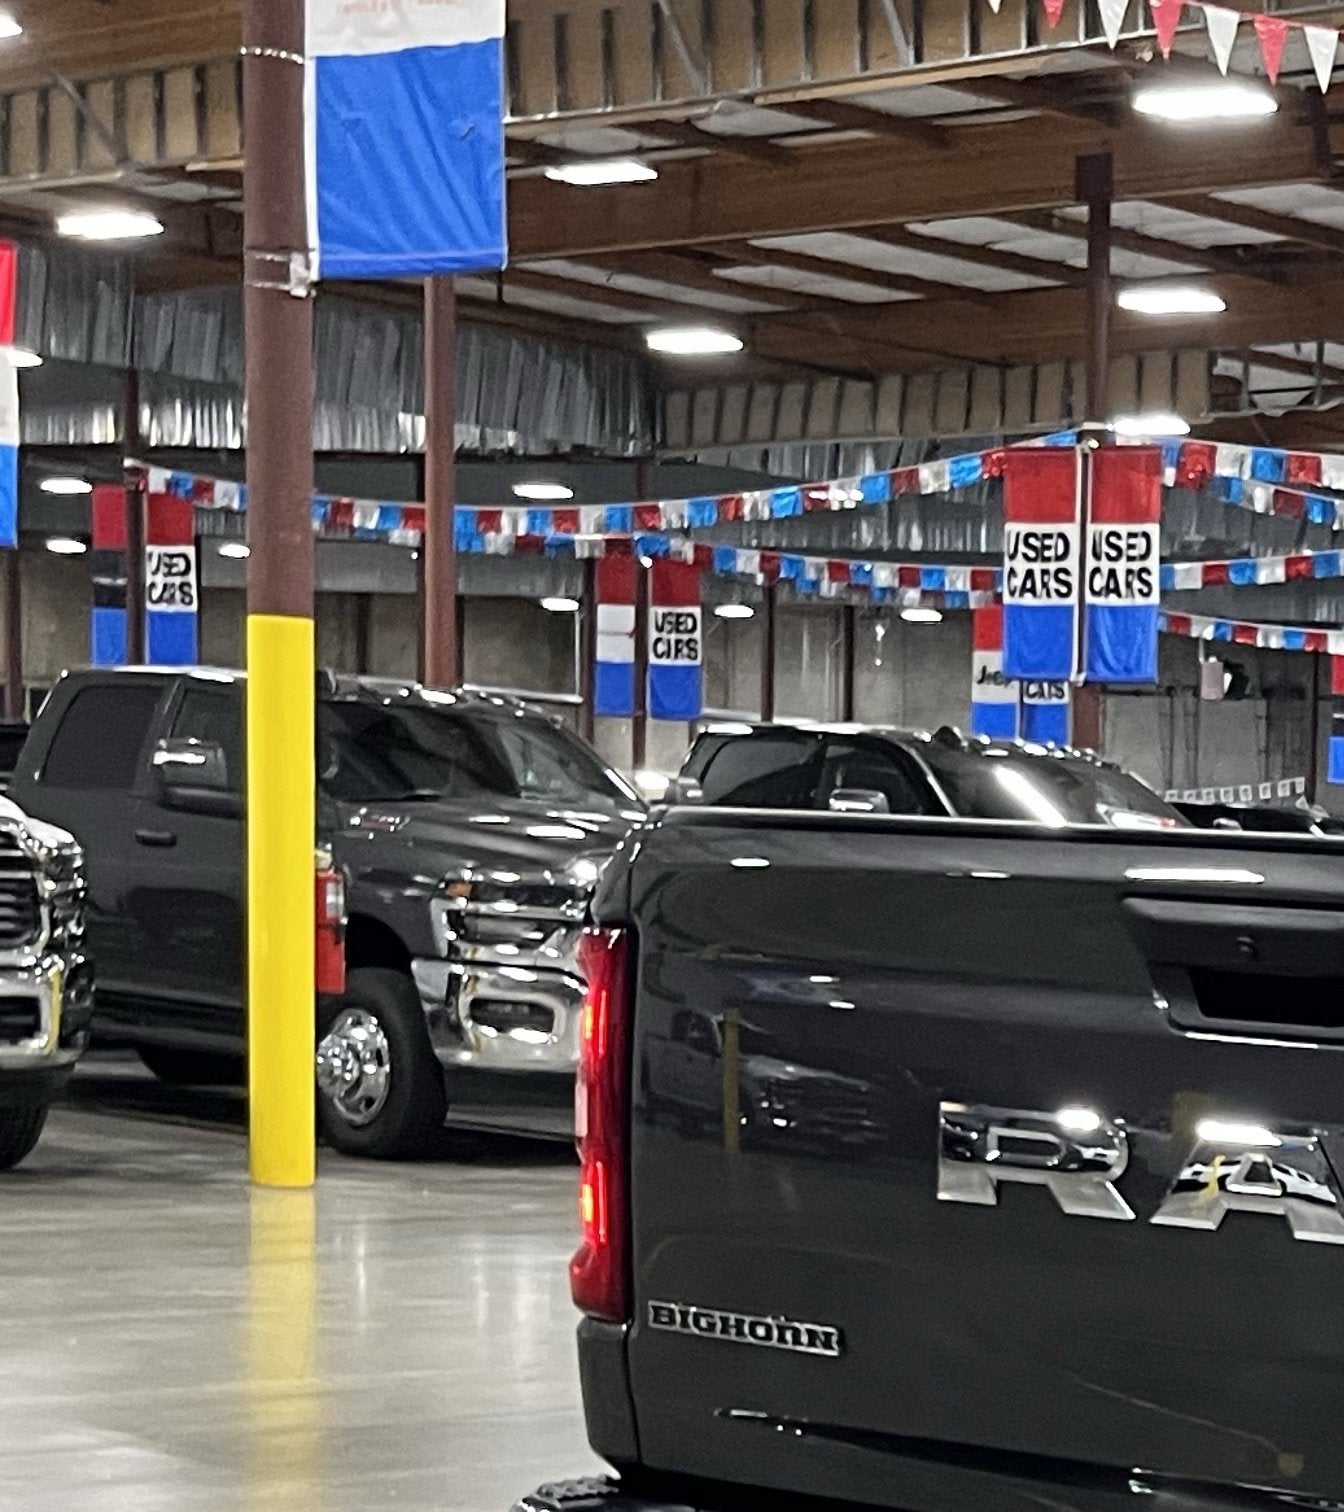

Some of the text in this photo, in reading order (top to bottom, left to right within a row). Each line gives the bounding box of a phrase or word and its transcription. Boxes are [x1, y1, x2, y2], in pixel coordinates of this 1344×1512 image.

[1008, 530, 1071, 562] USED
[1091, 530, 1152, 562] USED
[1006, 567, 1073, 599] CARS
[1088, 566, 1154, 598] CARS
[648, 1300, 840, 1357] BIGHORN
